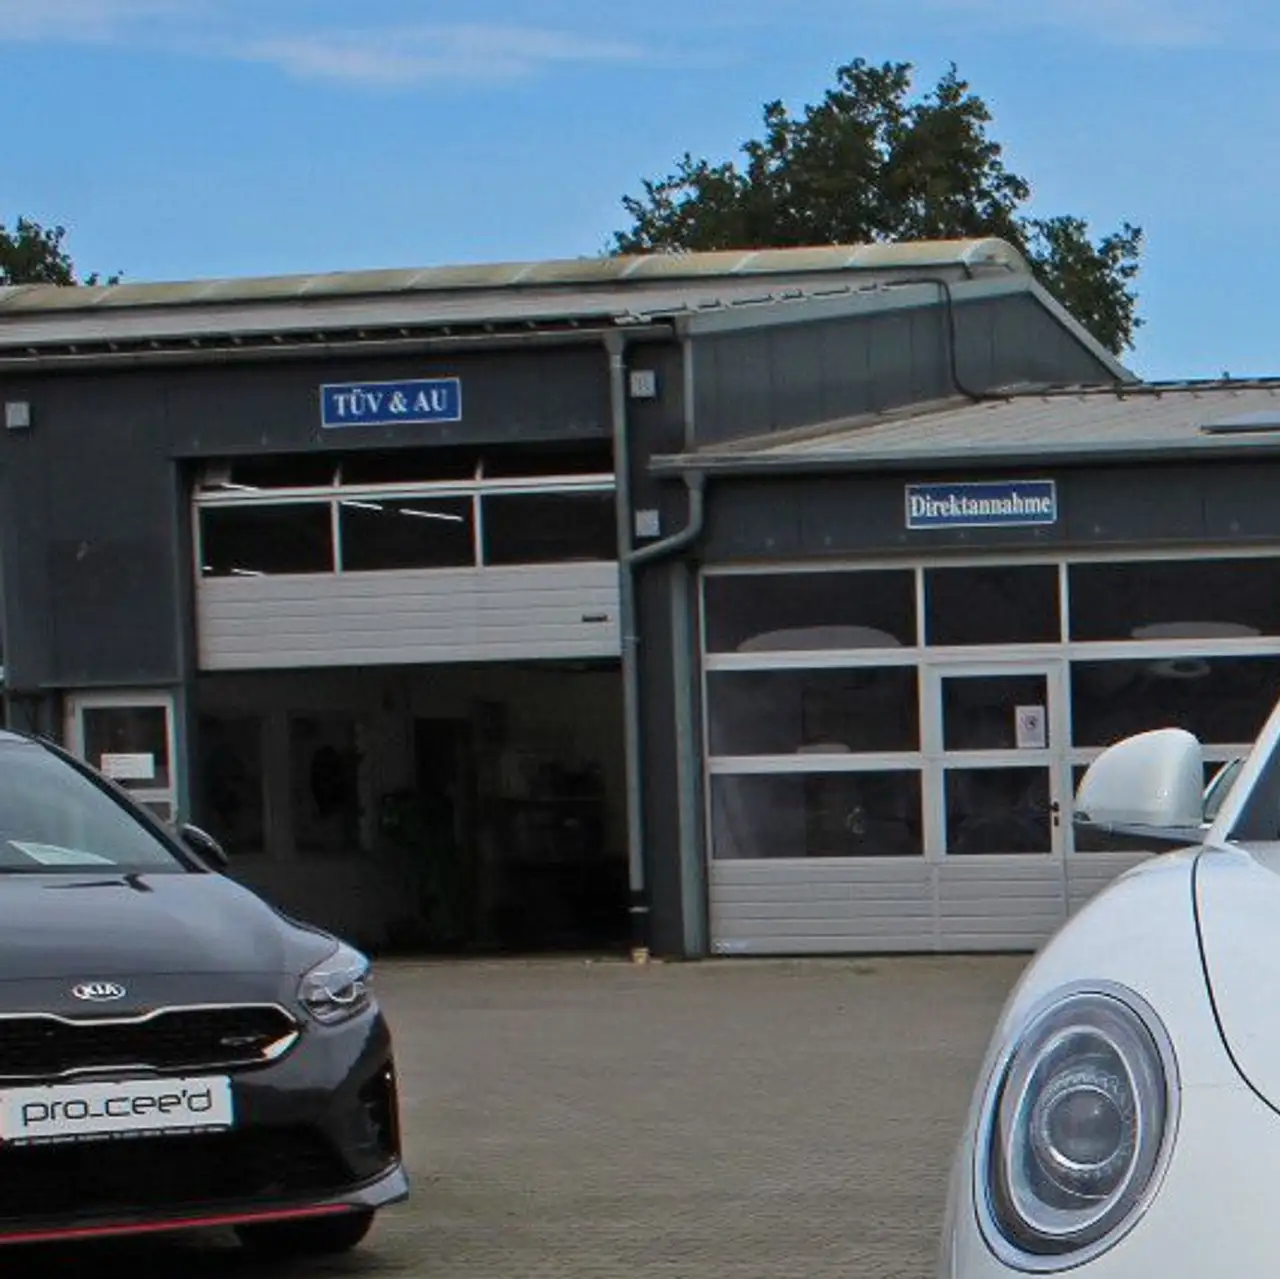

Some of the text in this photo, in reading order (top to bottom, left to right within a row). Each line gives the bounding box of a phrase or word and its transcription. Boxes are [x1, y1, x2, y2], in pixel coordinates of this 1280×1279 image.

[333, 389, 447, 417] TÜV & AU
[910, 491, 1050, 518] Direktannahme
[22, 1088, 213, 1127] pro_cee'd
